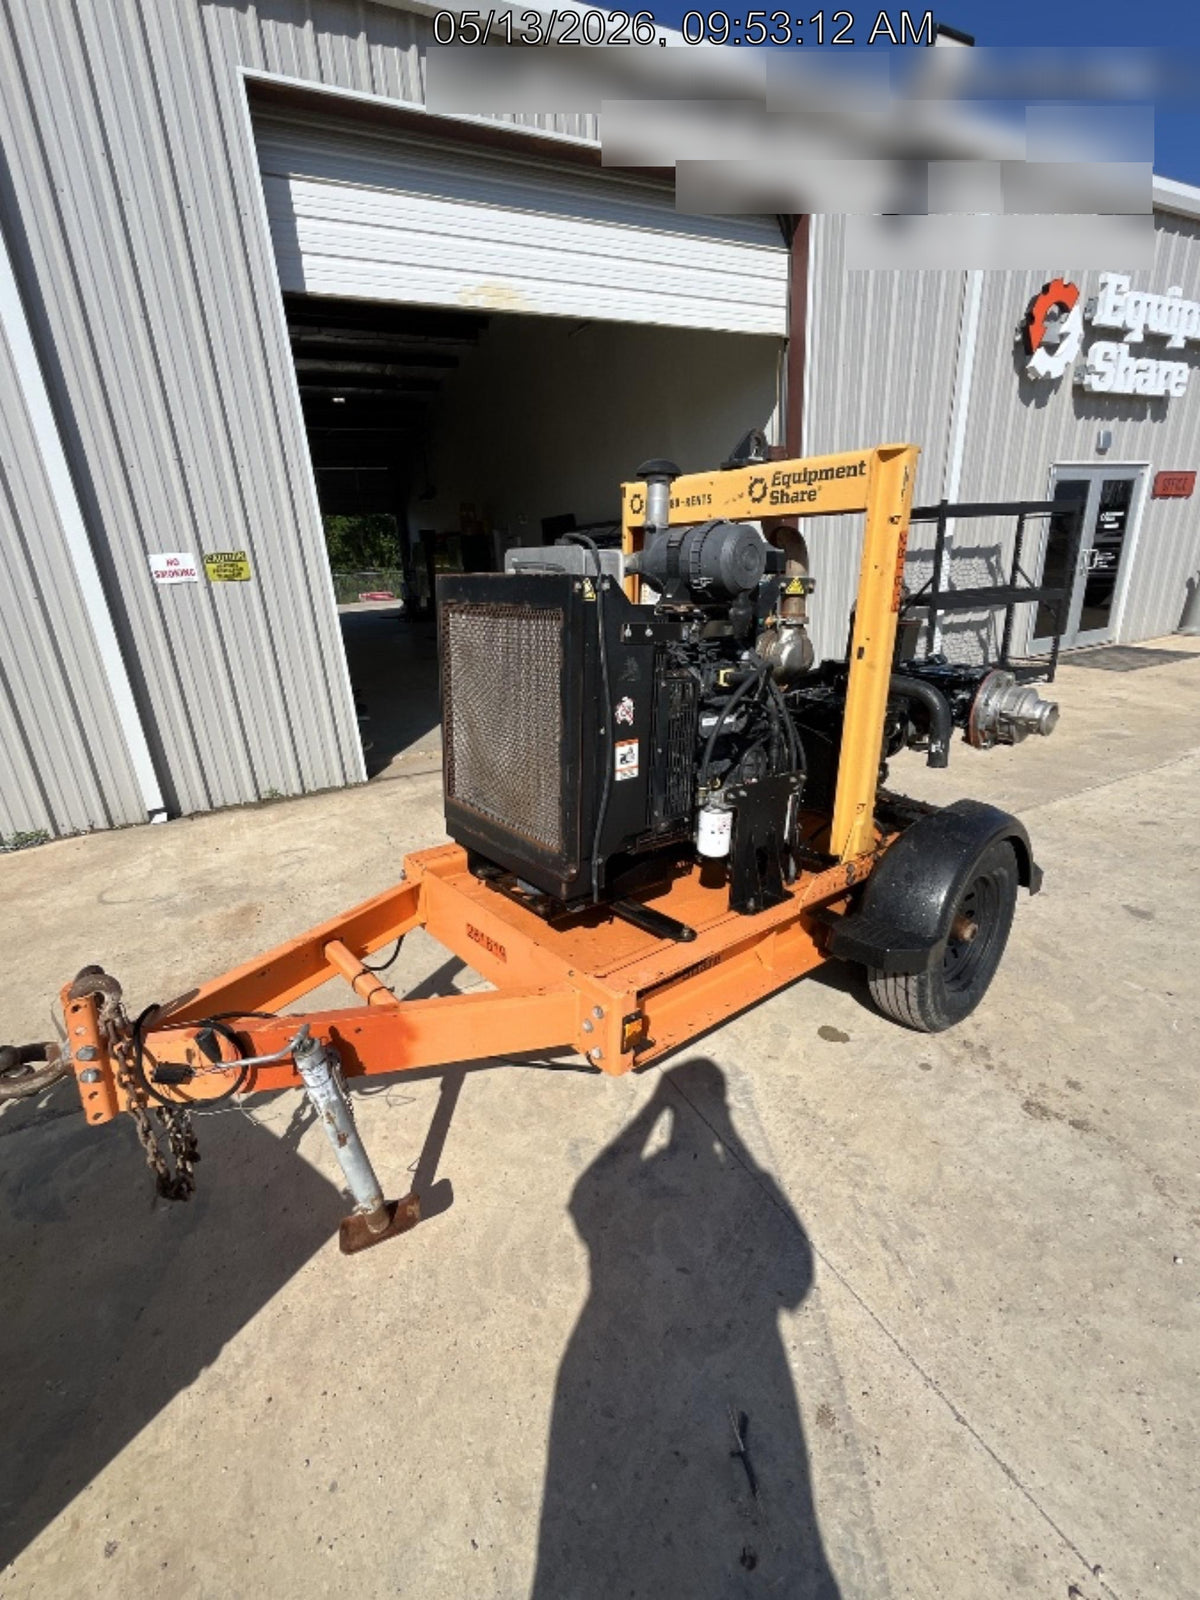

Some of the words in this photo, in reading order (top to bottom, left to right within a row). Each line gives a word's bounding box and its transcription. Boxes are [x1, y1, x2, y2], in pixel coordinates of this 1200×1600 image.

[1083, 340, 1190, 397] Share
[771, 460, 867, 489] Equipment
[769, 489, 817, 505] Share
[166, 558, 180, 567] NO
[154, 568, 196, 579] SMOKING
